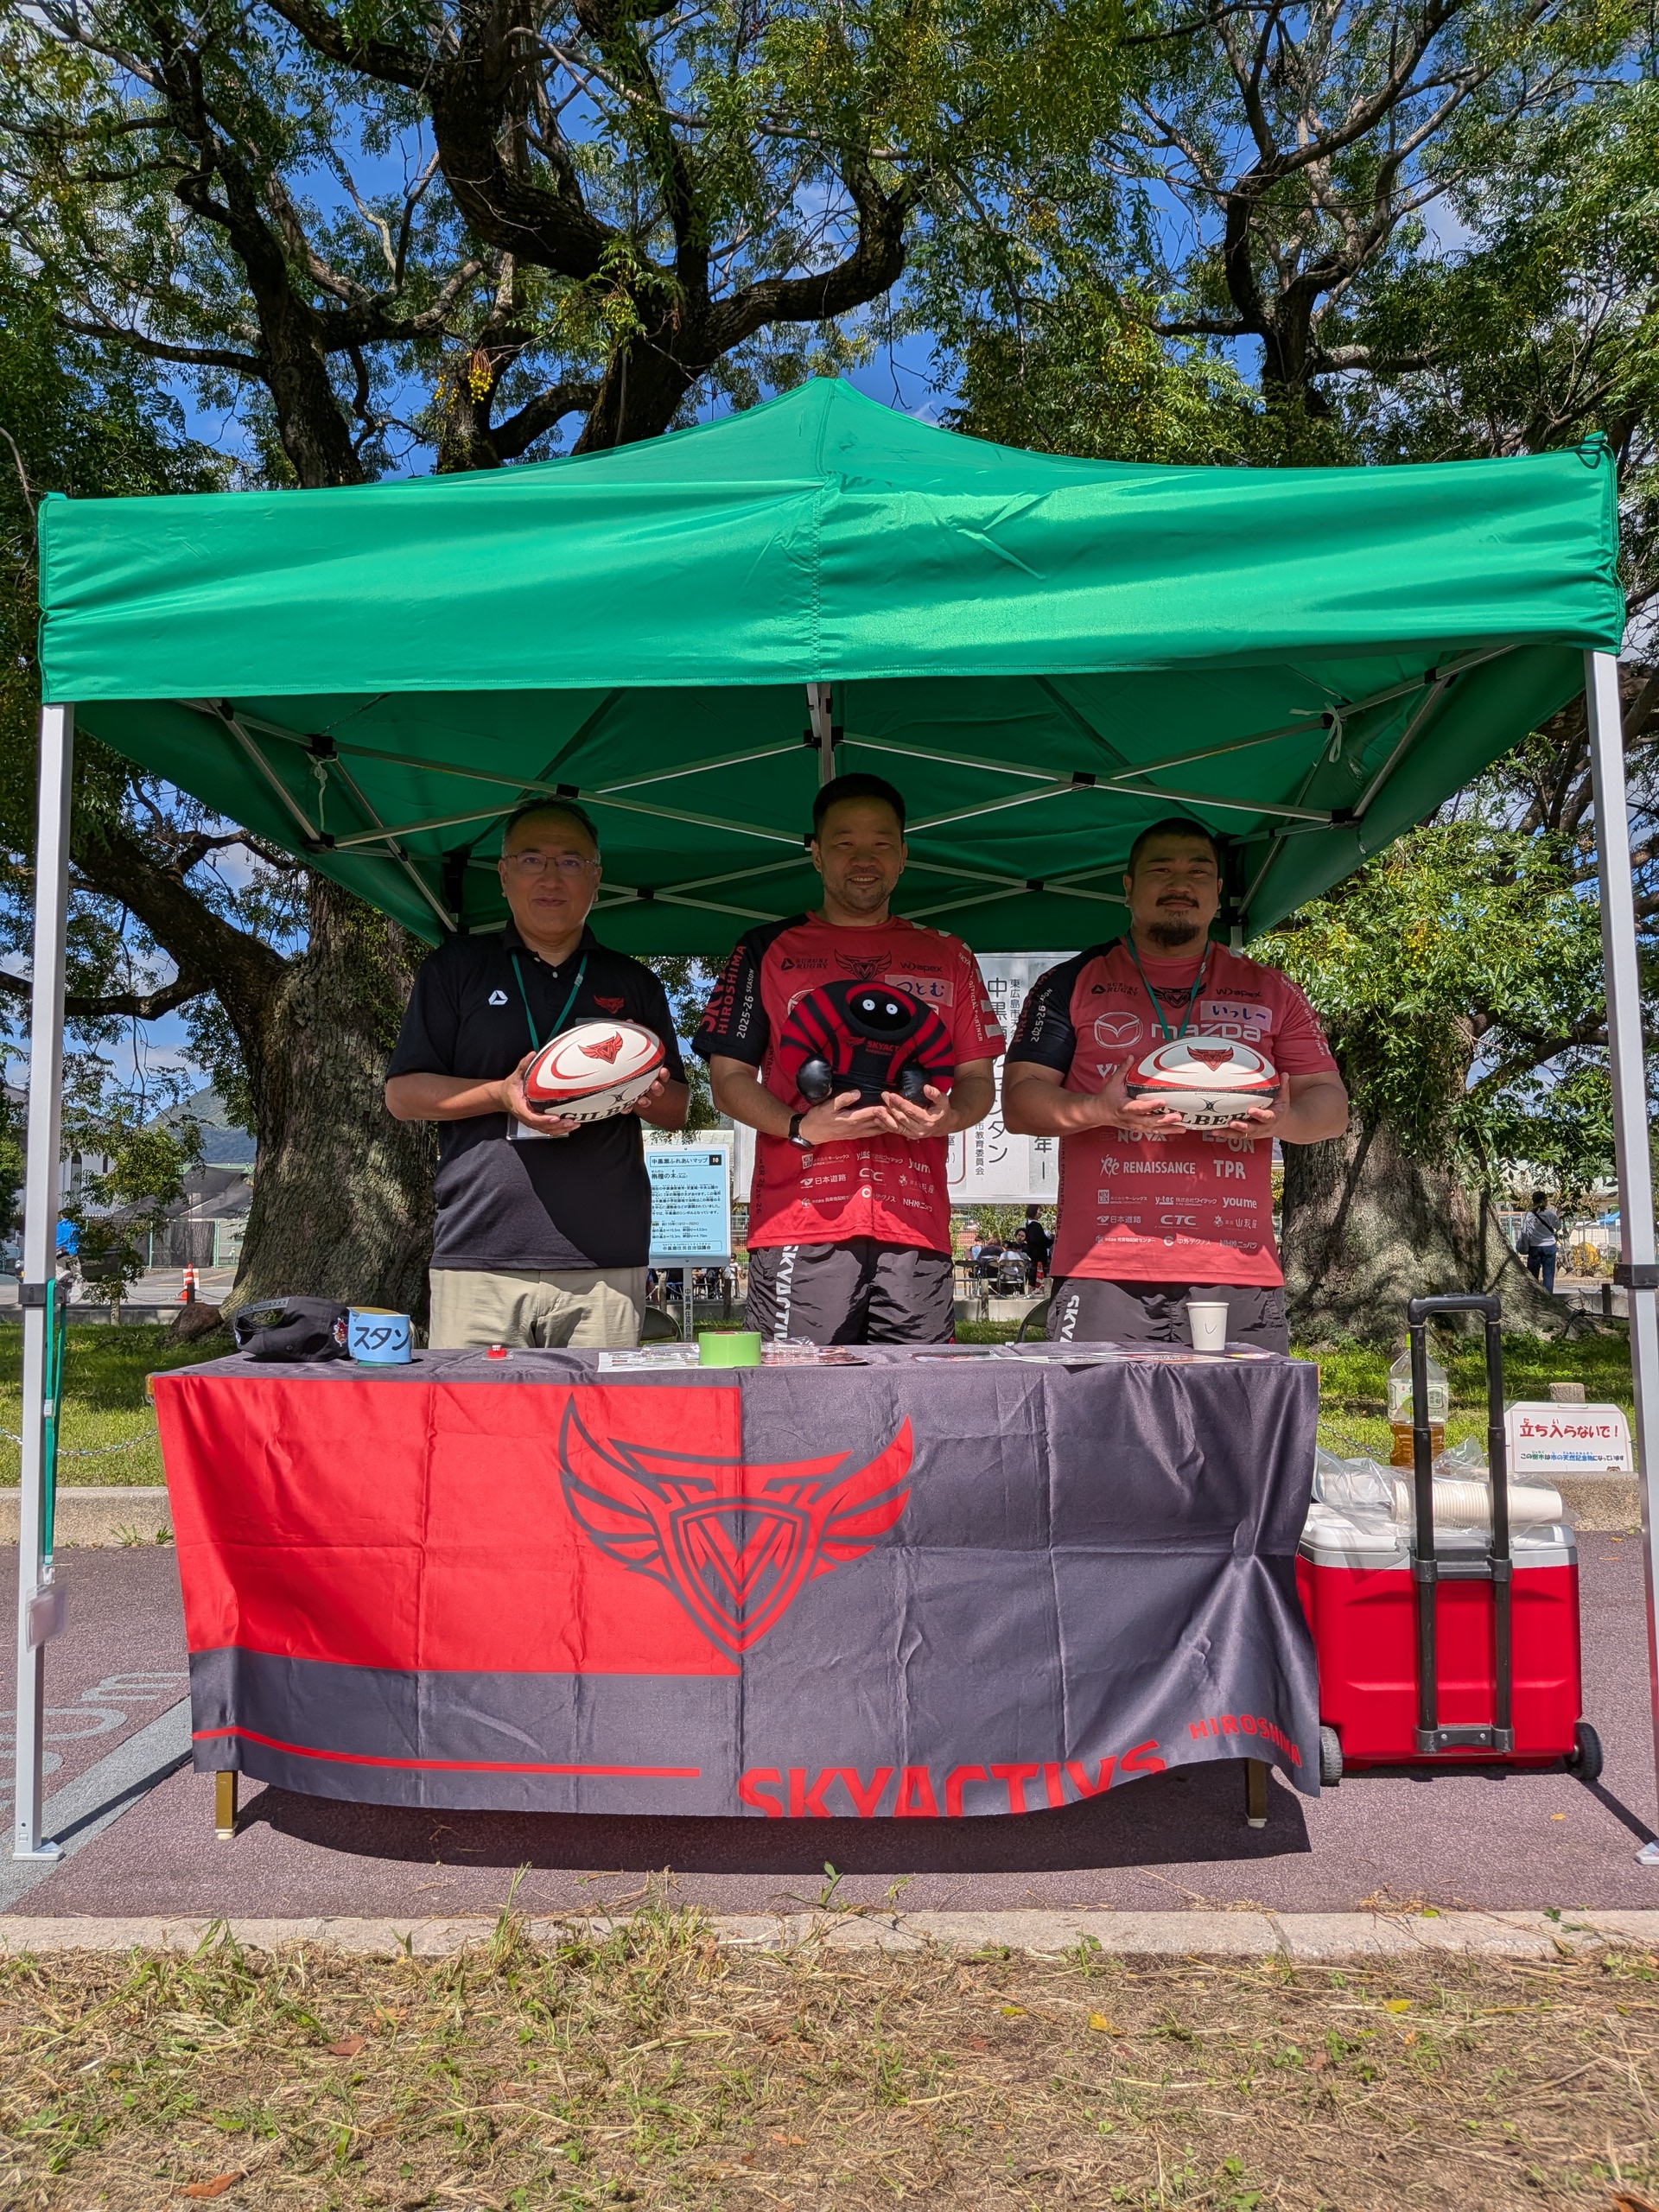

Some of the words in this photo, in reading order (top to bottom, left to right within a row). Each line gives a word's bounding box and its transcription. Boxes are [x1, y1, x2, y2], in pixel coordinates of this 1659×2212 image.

[716, 945, 747, 1034] HIROSHIMA
[896, 982, 944, 997] つとむ
[1107, 982, 1138, 991] SUZUKI
[1107, 987, 1138, 996] RUGBY
[736, 995, 754, 1039] 2025-26
[746, 969, 754, 993] SEASON
[1031, 1005, 1046, 1042] 2025-26
[1123, 1161, 1196, 1174] RENAISSANCE
[1213, 1160, 1246, 1179] TPR
[815, 1173, 847, 1185] 日本道路
[1223, 1197, 1257, 1208] youme
[1160, 1215, 1197, 1225] CTC
[1188, 1713, 1302, 1769] HIROSHIMA
